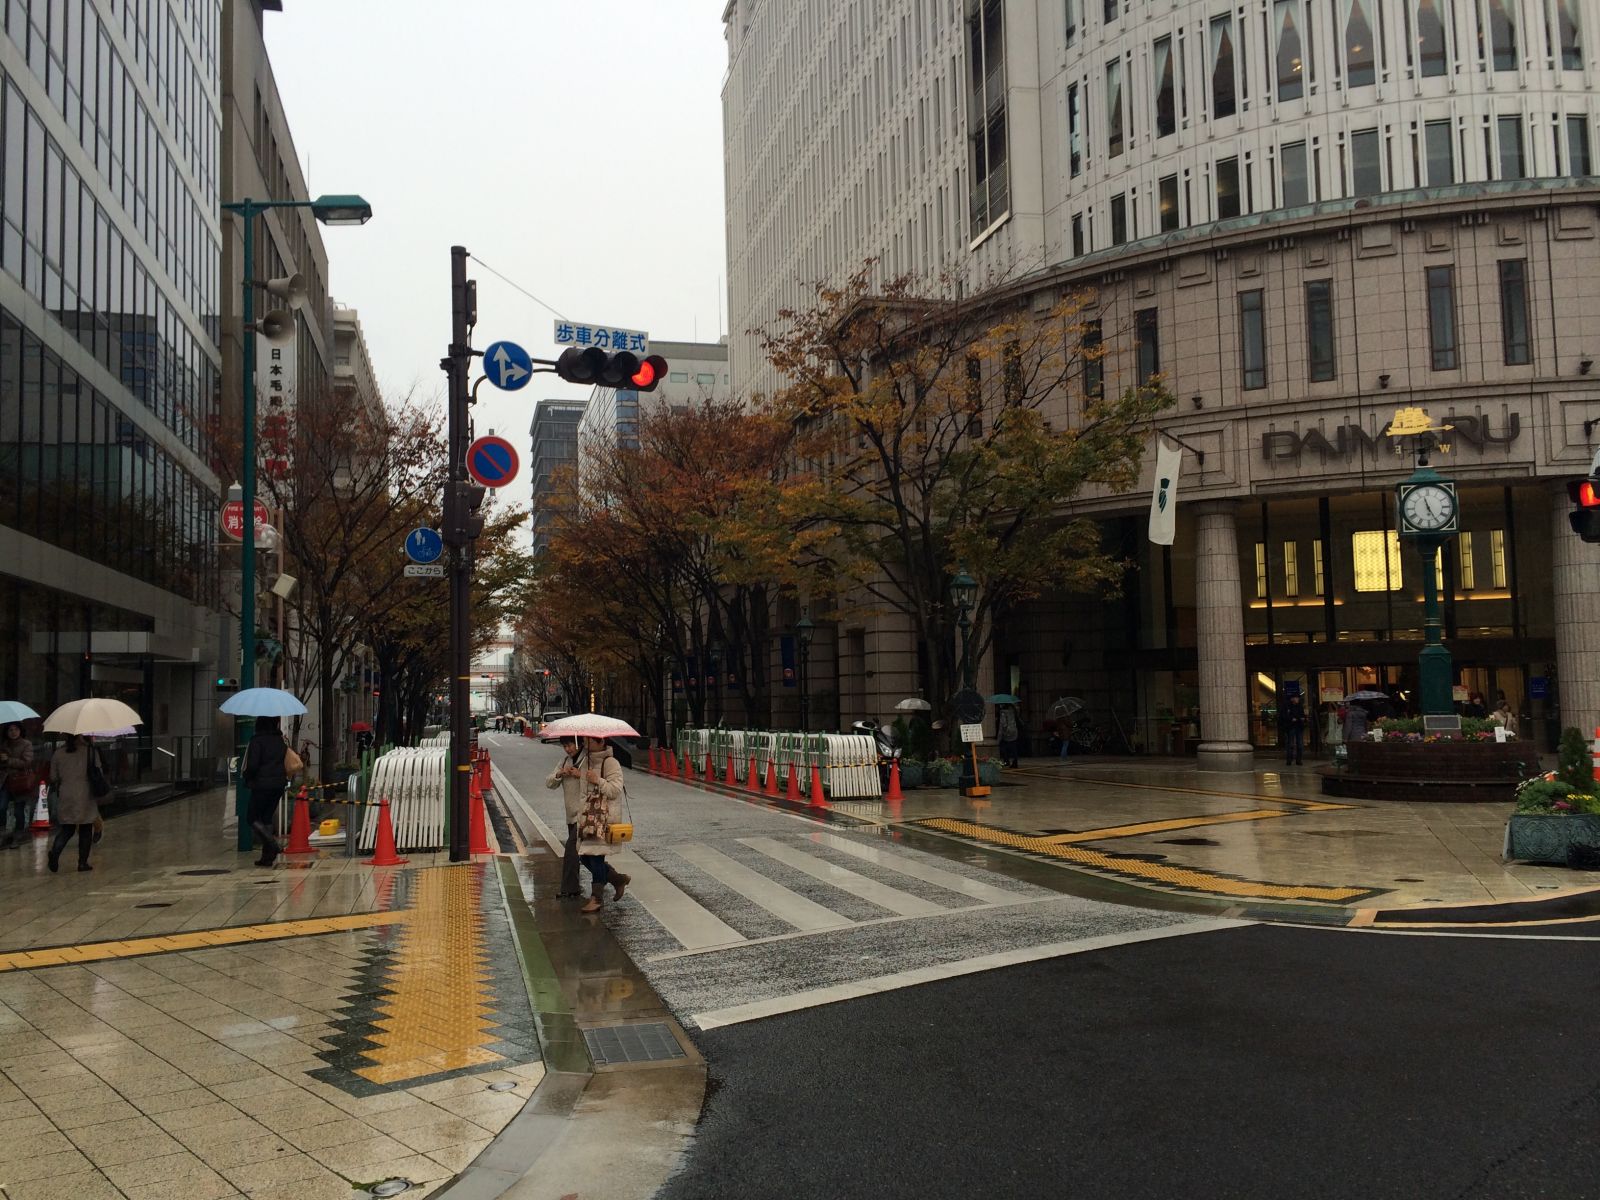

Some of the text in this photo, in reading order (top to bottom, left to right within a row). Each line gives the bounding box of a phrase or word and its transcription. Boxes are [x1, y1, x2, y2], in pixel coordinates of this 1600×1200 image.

[556, 323, 646, 352] 歩車分離式
[227, 515, 263, 529] 消栓
[408, 566, 441, 575] ここから
